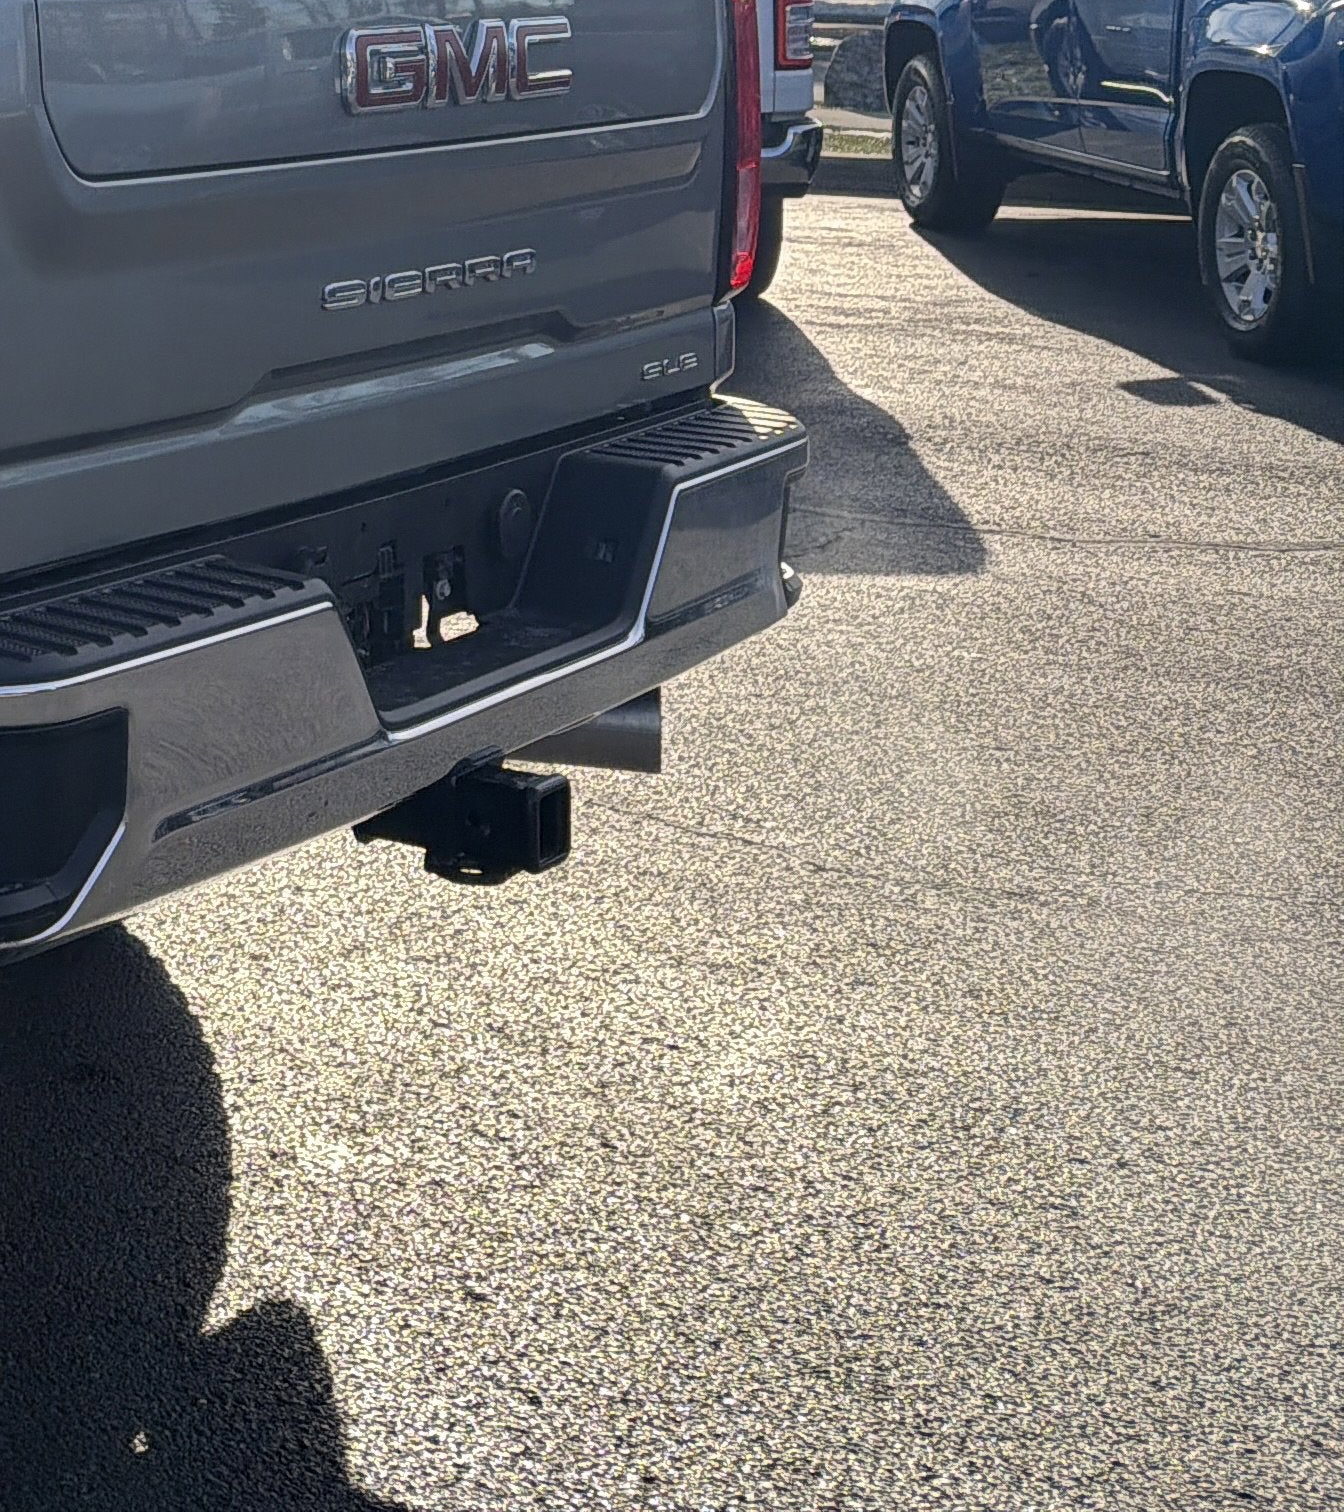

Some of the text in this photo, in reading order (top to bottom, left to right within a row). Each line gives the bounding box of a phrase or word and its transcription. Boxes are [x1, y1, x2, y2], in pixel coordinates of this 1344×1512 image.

[340, 15, 573, 116] GMC
[321, 247, 537, 311] SIERRA
[642, 352, 698, 380] SLE
